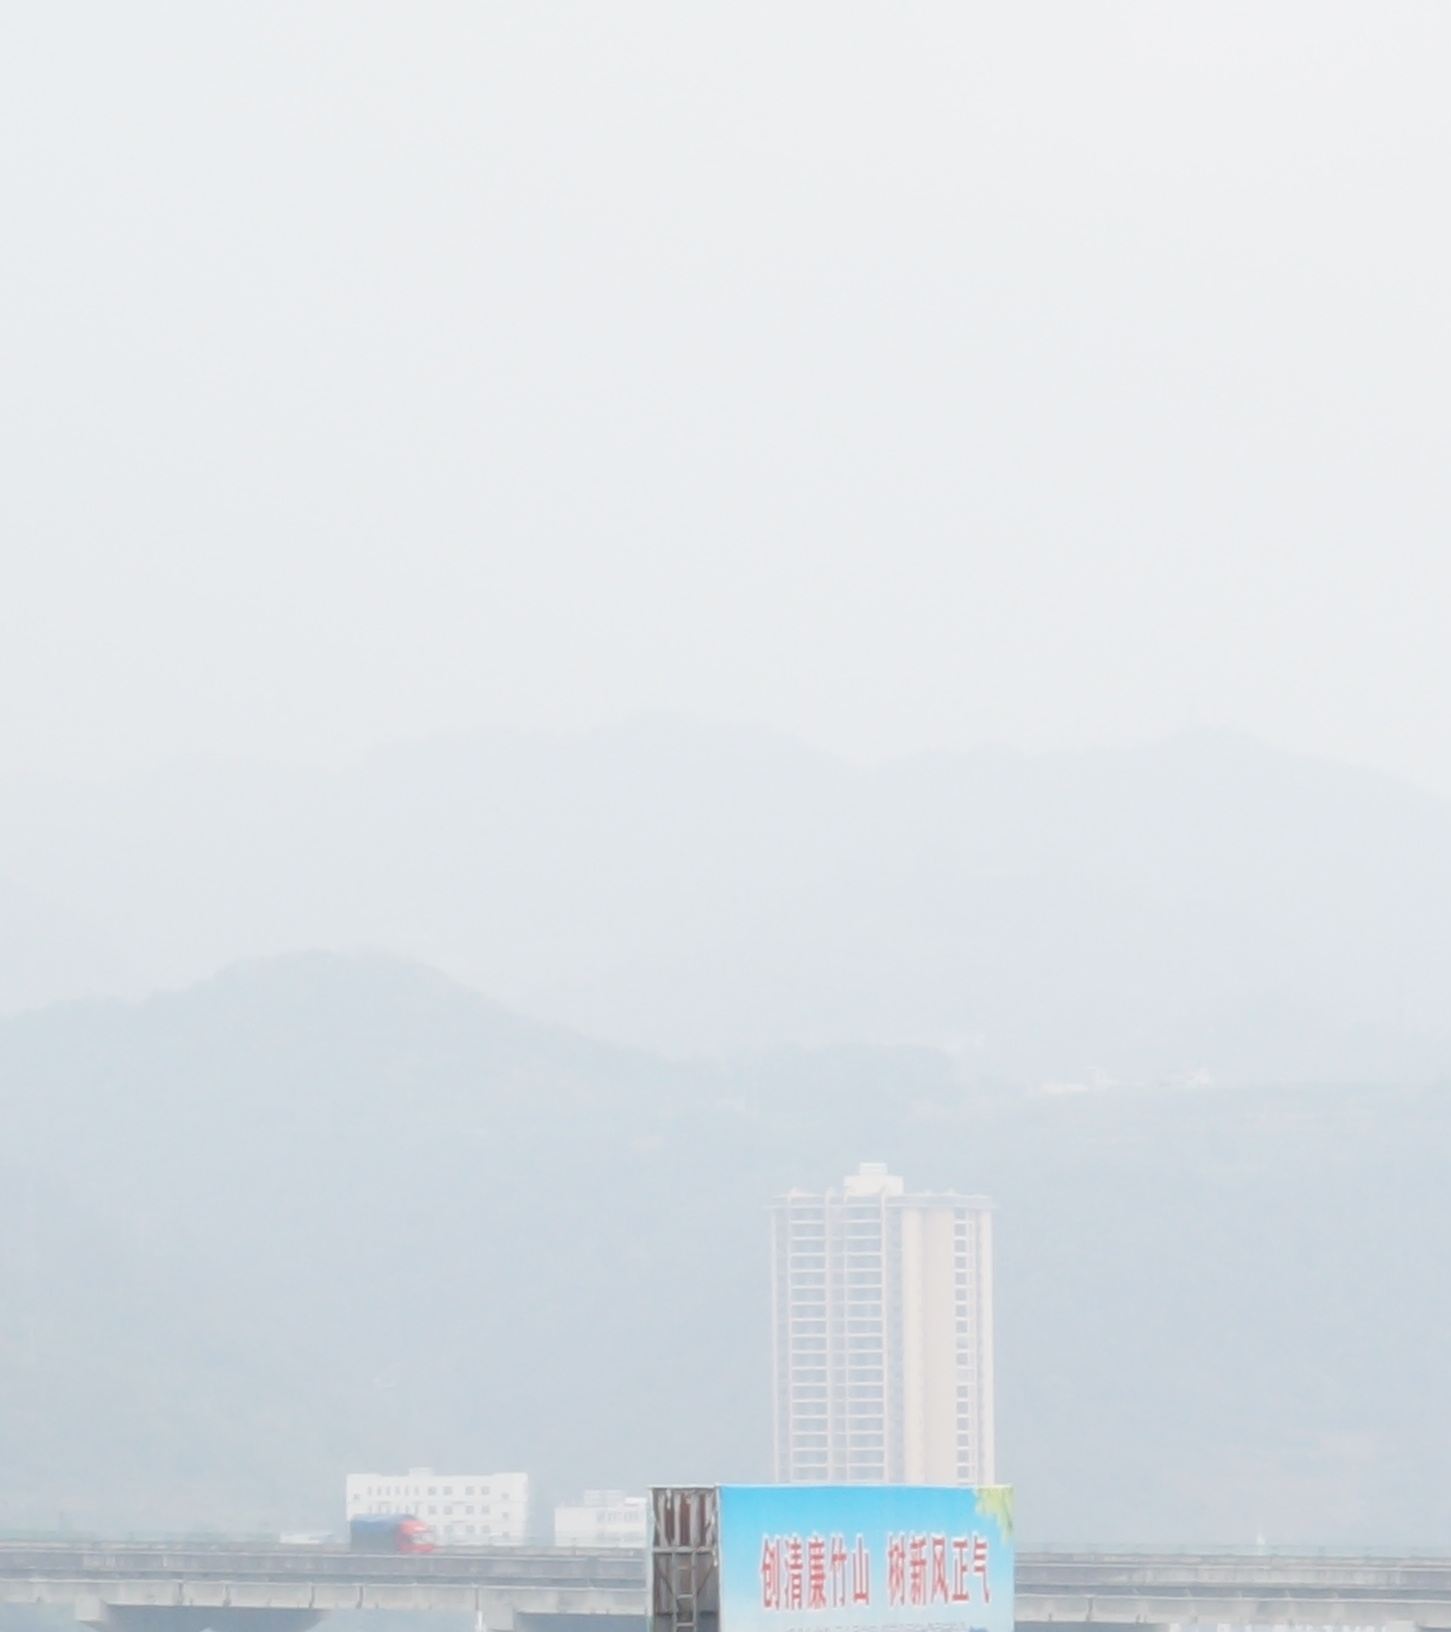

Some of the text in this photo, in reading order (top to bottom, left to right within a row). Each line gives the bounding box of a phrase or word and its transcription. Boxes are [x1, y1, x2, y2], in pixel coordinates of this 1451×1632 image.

[761, 1531, 991, 1611] 创清廉竹山 树新风正气
